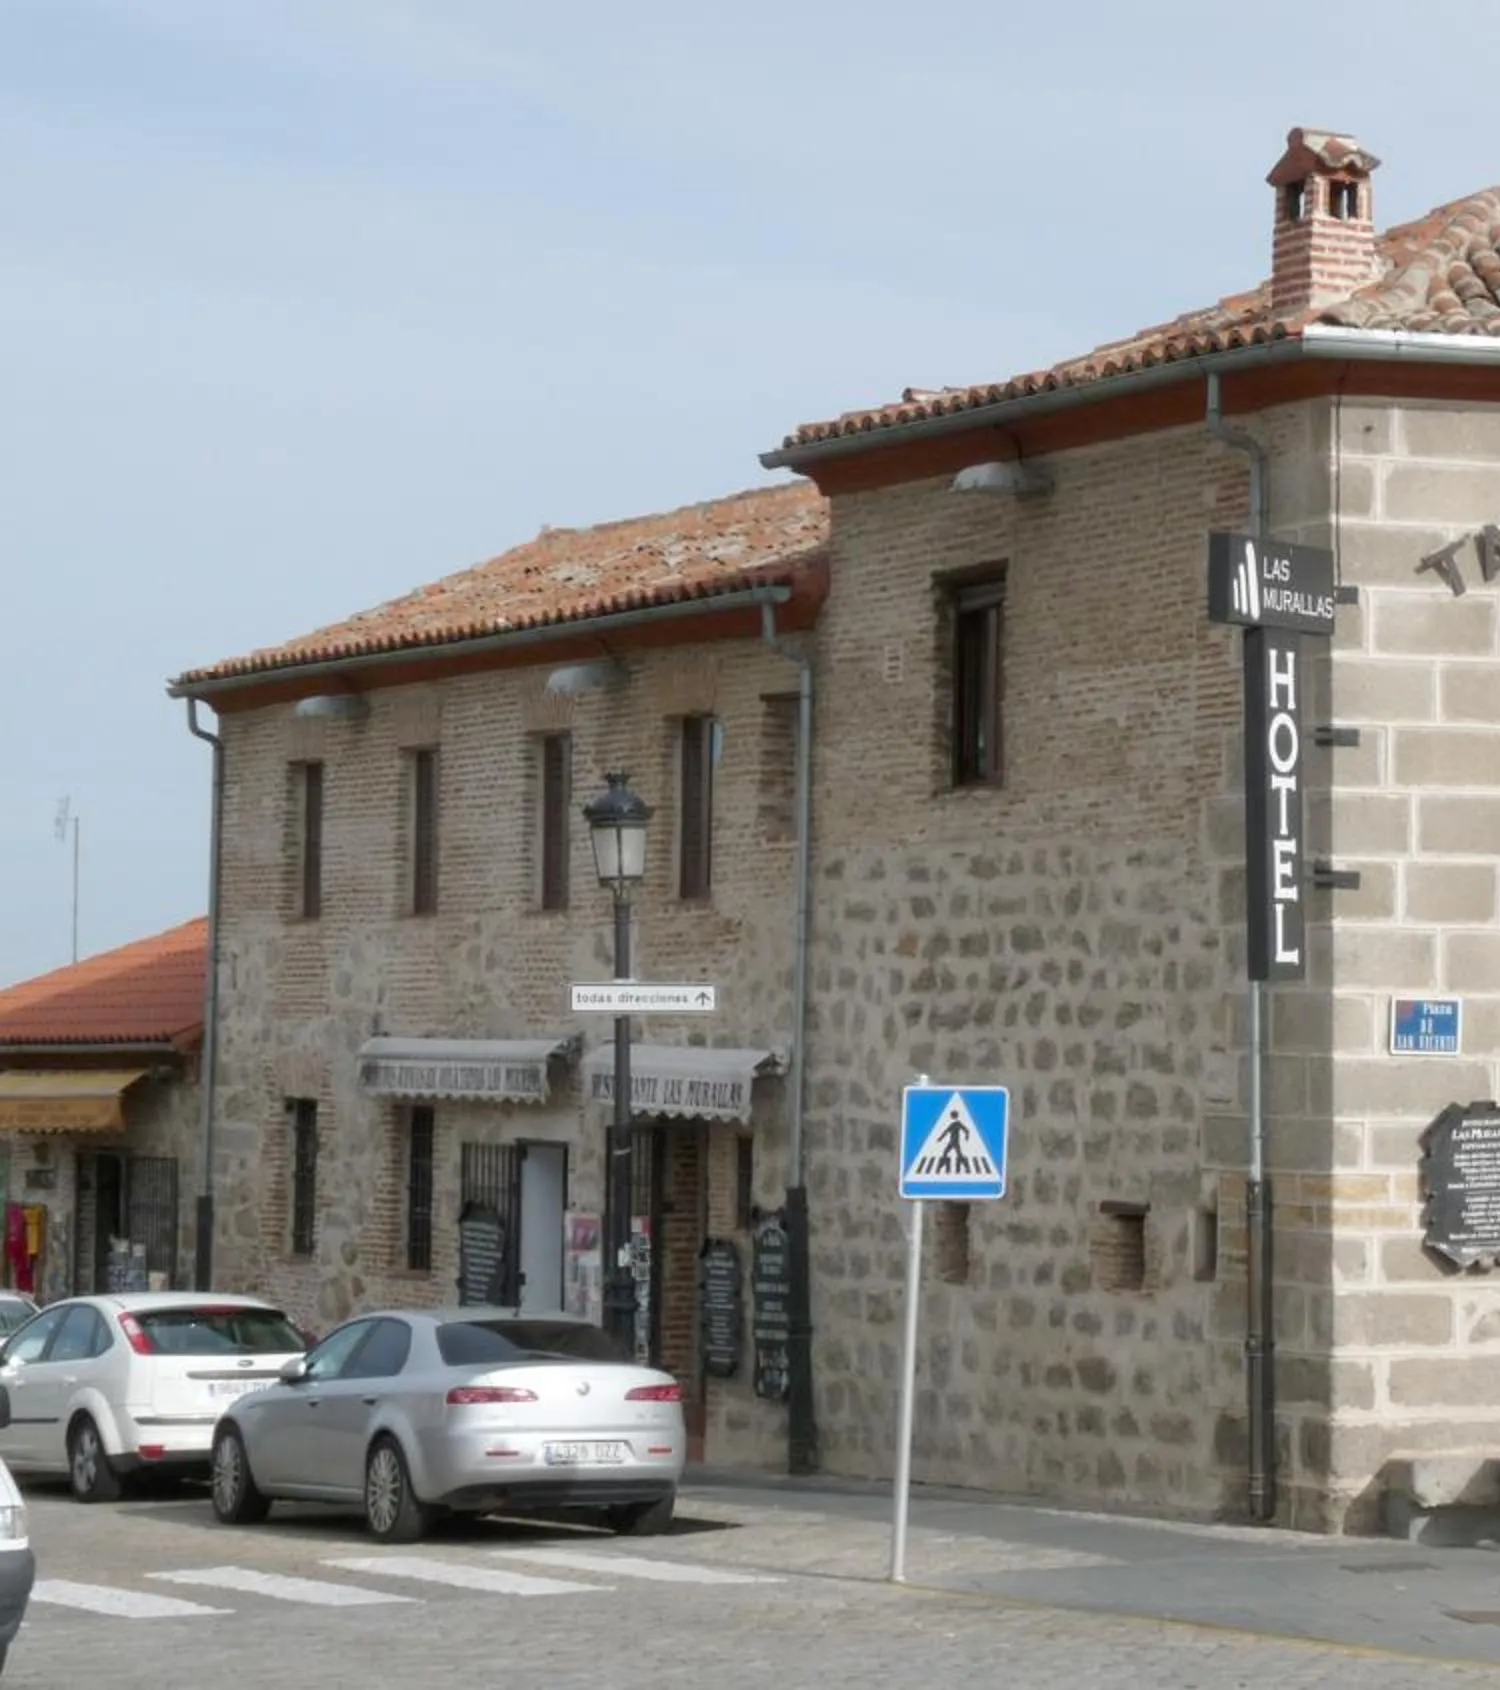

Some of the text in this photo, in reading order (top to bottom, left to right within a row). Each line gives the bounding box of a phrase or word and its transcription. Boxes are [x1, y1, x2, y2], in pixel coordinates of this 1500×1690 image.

[1263, 556, 1291, 582] LAS
[1263, 589, 1334, 620] MURALLAS
[1268, 648, 1299, 965] HOTEL
[576, 991, 689, 1004] todas direcciones
[663, 1078, 683, 1106] LAS
[686, 1080, 744, 1110] MURALLAS
